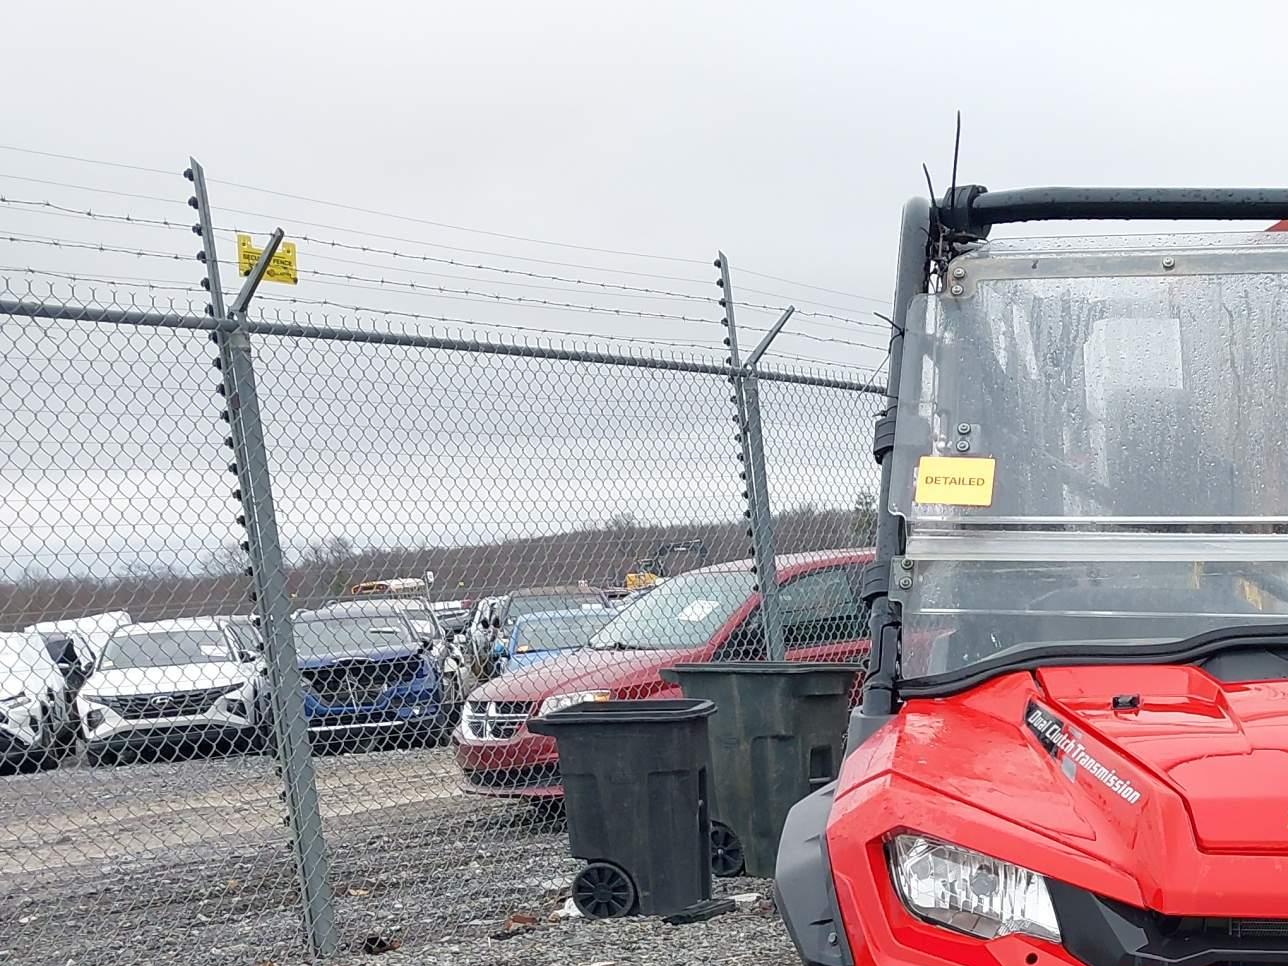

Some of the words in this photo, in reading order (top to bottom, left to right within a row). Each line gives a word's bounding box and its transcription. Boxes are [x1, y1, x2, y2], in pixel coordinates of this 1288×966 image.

[924, 475, 985, 487] DETAILED
[1027, 708, 1053, 733] Dual
[1045, 721, 1077, 755] Clutch
[1071, 744, 1142, 805] Transmission
